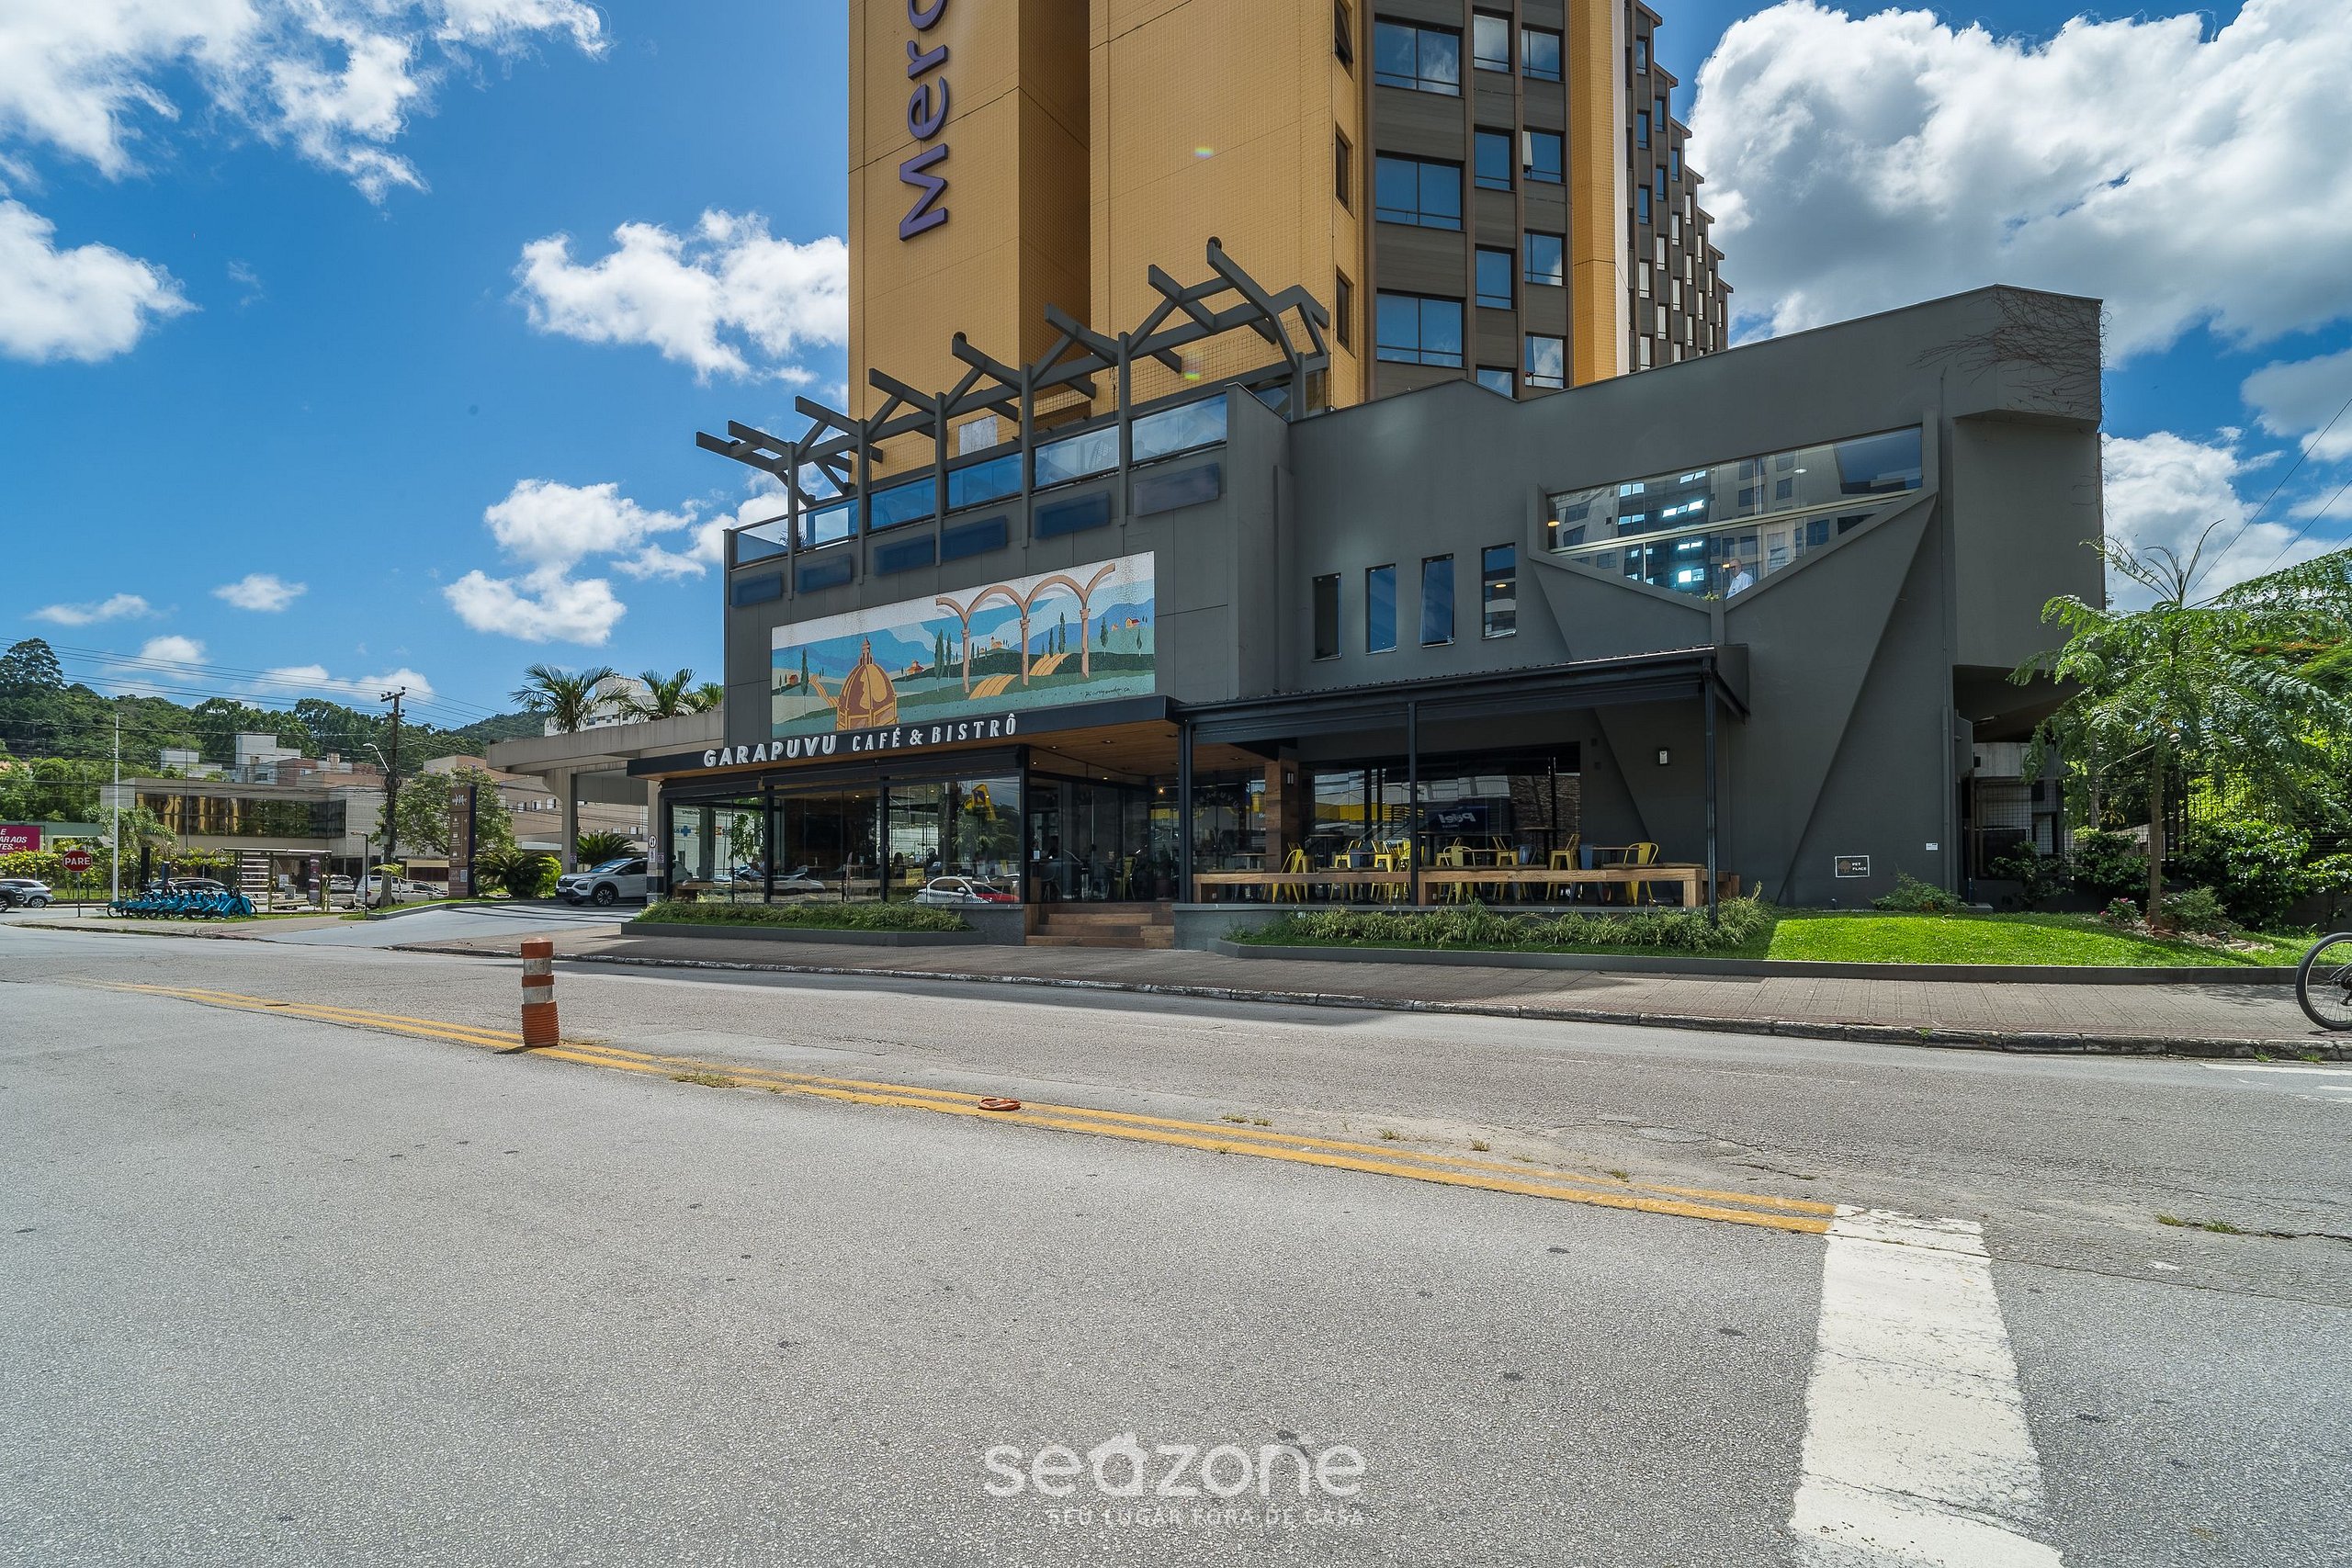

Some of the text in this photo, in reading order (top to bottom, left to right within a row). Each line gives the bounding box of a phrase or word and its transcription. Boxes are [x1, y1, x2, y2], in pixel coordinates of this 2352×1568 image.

[703, 713, 1017, 767] GARAPUVU CAFÉ & BISTRÔ
[64, 857, 91, 865] PARE
